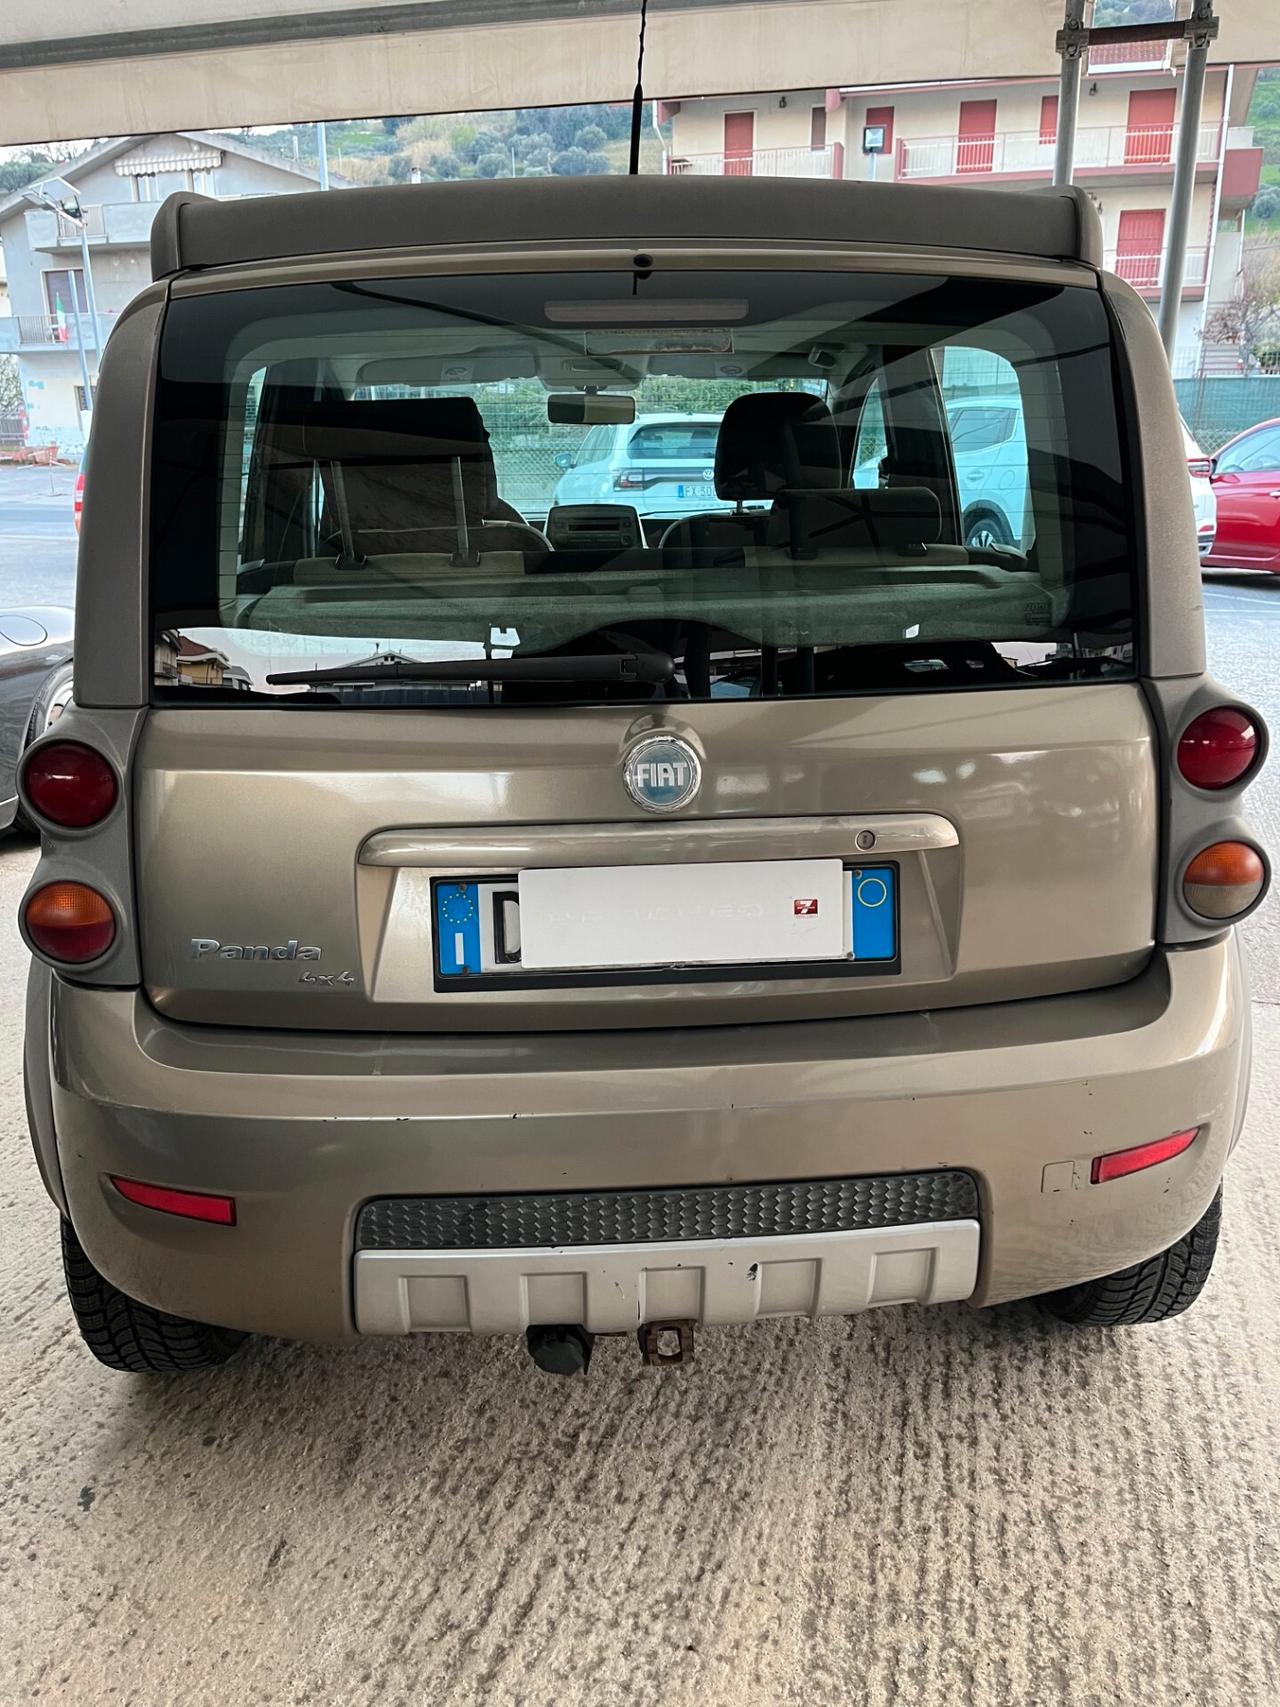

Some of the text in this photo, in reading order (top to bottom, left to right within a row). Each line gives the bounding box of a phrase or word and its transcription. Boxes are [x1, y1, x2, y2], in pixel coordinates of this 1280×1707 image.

[636, 761, 688, 788] FIAT
[190, 938, 322, 961] Panda
[298, 970, 356, 986] 4x4
